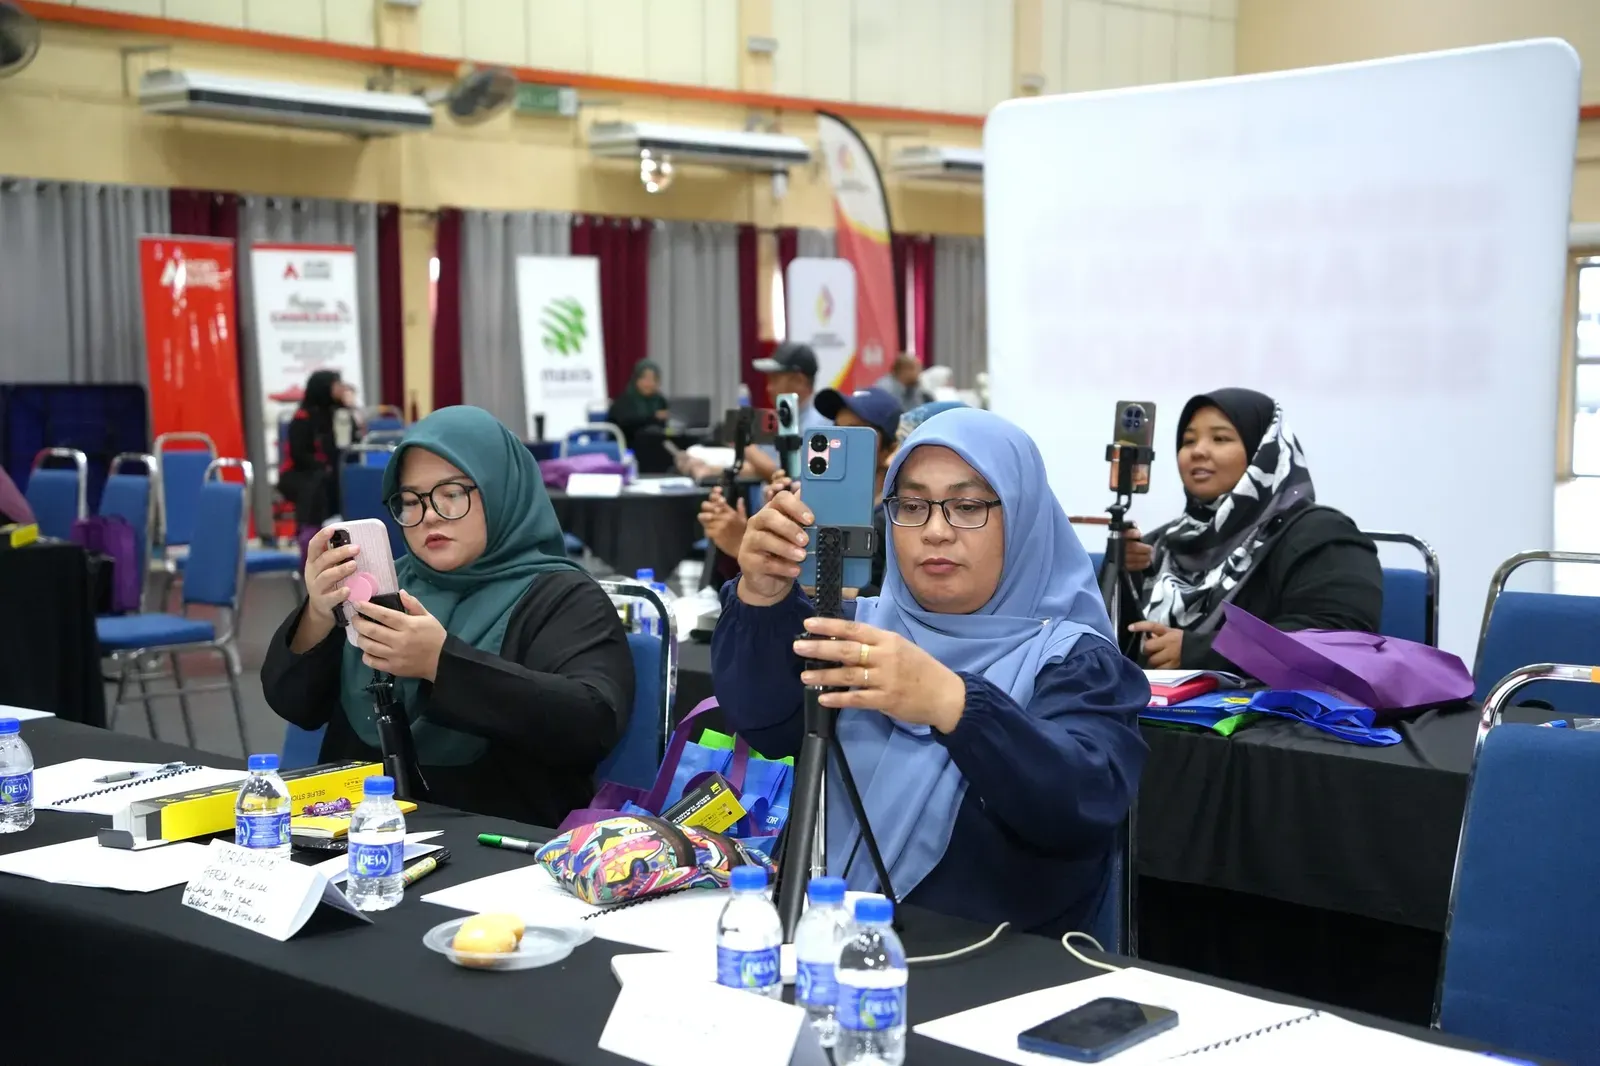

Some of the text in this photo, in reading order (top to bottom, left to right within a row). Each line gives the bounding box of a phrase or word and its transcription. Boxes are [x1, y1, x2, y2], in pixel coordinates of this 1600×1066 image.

[4, 783, 28, 795] DESA
[291, 789, 326, 802] SELFIE STIC
[359, 854, 388, 867] DESA
